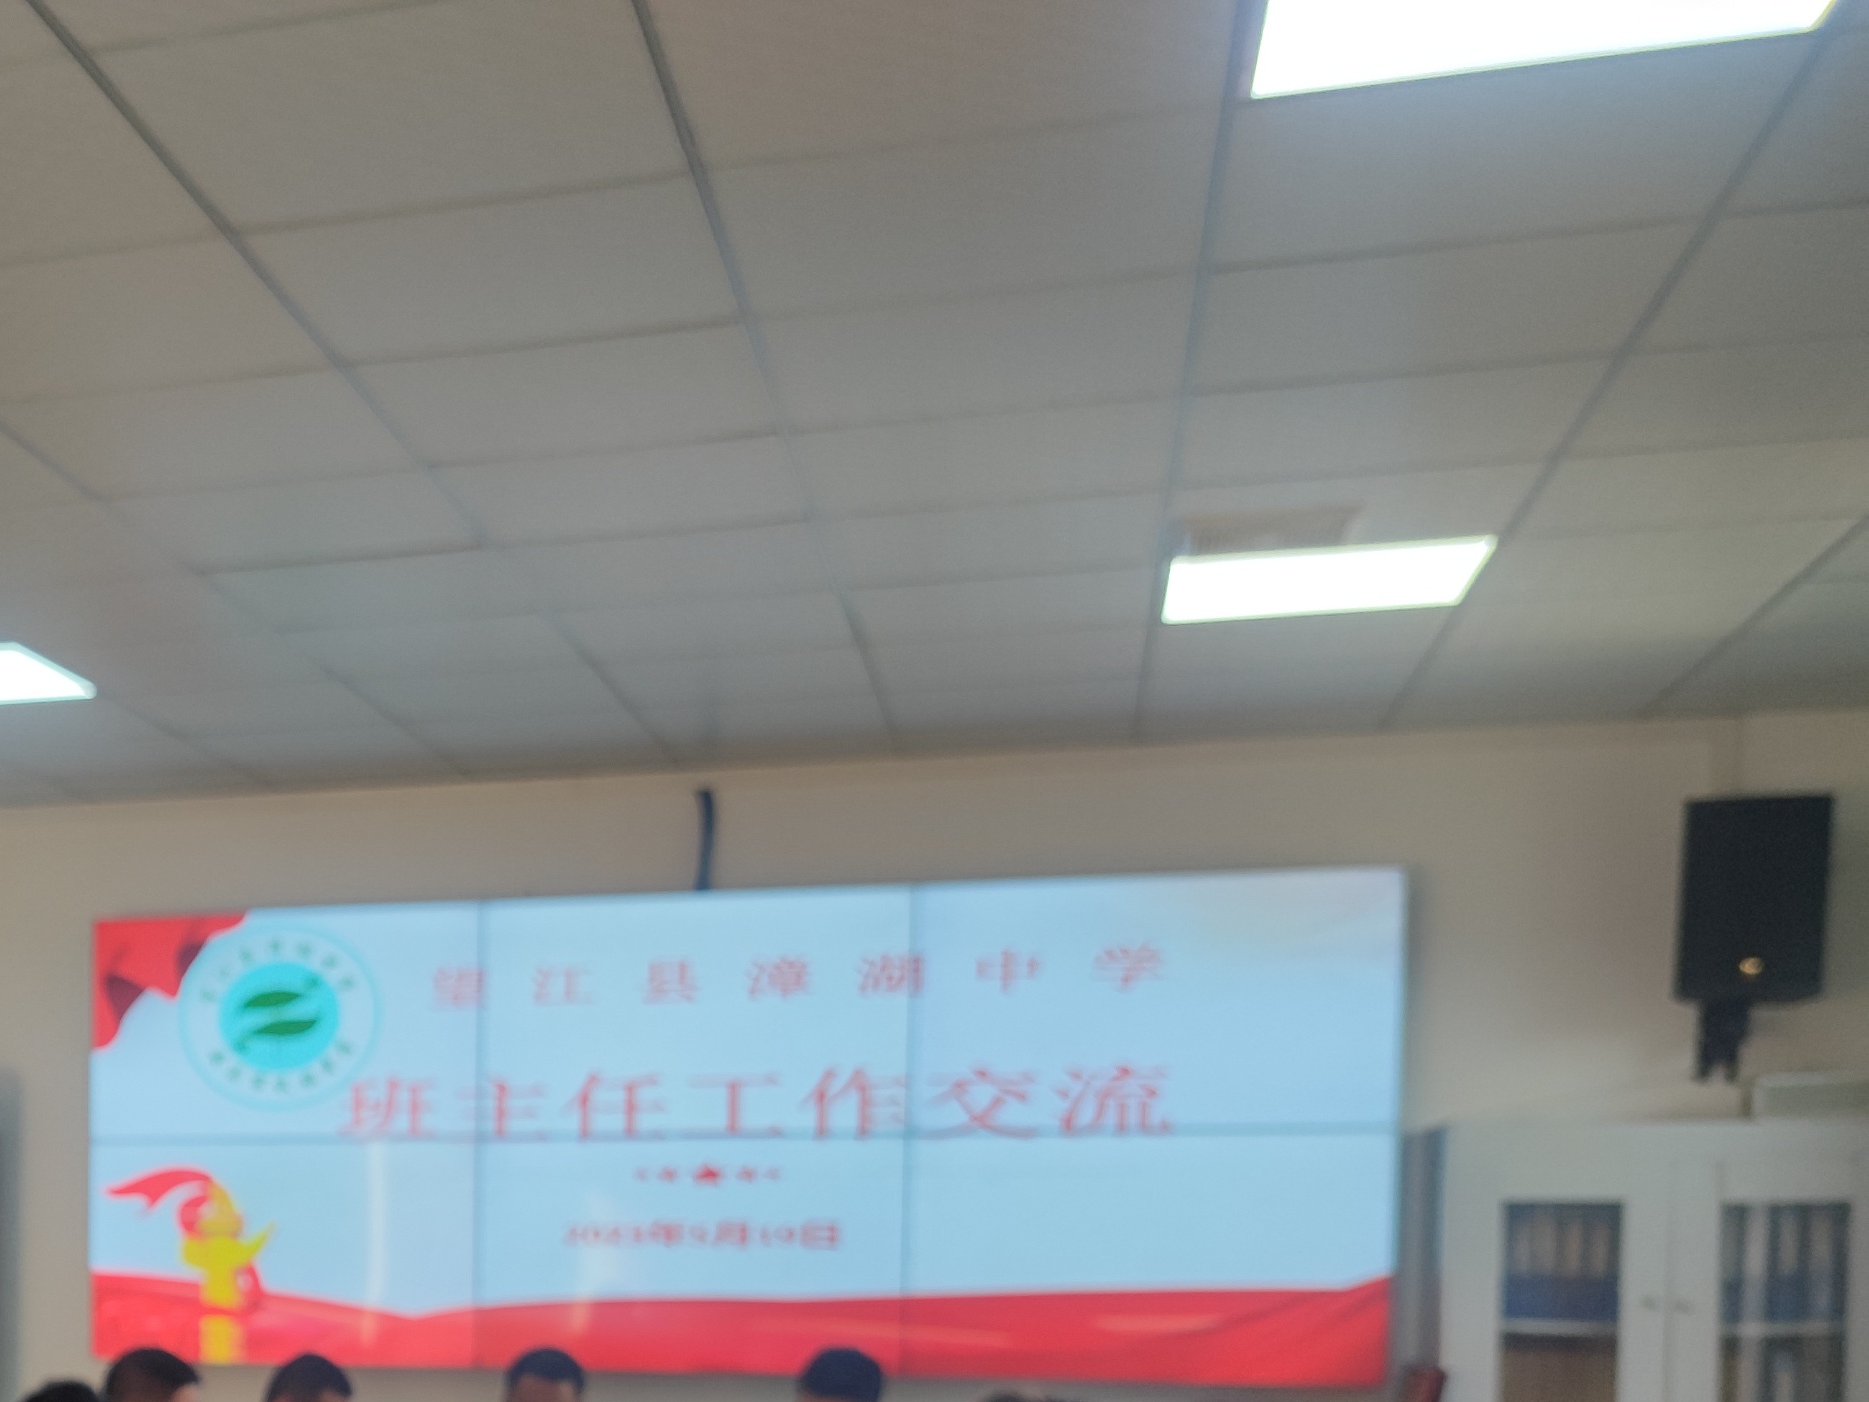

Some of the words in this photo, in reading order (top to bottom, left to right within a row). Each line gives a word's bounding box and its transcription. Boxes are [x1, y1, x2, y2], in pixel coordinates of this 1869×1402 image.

[340, 1063, 1174, 1141] 班主任工作交流
